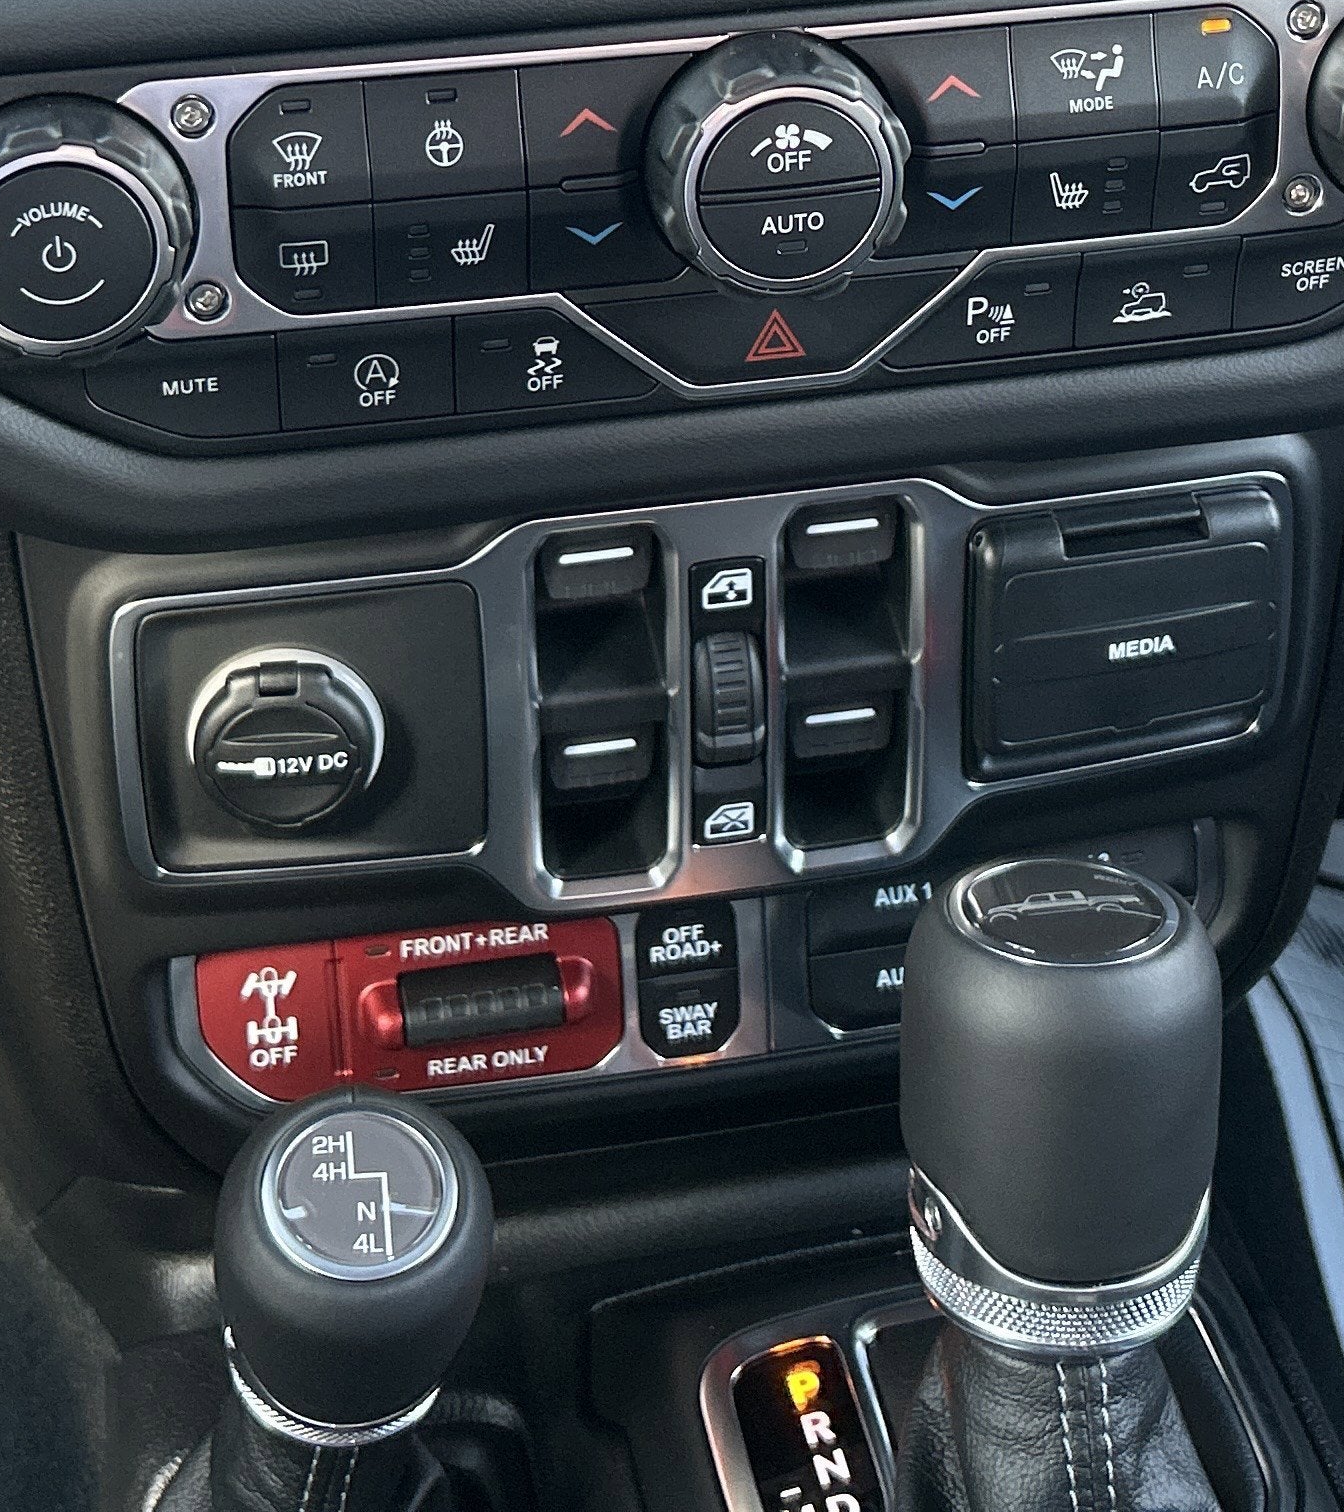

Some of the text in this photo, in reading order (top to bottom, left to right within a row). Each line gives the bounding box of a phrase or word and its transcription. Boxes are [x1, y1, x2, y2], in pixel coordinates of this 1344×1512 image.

[1197, 64, 1245, 90] A/C
[1069, 96, 1114, 113] MODE
[767, 150, 812, 174] OFF
[273, 171, 328, 189] FRONT
[17, 202, 90, 229] VOLUME
[761, 212, 824, 236] AUTO
[1296, 273, 1330, 292] OFF
[976, 328, 1012, 344] OFF
[162, 377, 219, 396] MUTE
[526, 373, 564, 392] OFF
[359, 388, 396, 406] OFF
[1108, 635, 1175, 661] MEDIA
[276, 751, 349, 775] 12V DC
[875, 882, 932, 907] AUX 1
[400, 923, 549, 958] FRONT+REAR
[662, 923, 705, 944] OFF
[649, 941, 723, 963] ROAD+
[876, 967, 904, 988] AU
[658, 1002, 718, 1025] SWAY
[666, 1019, 713, 1040] BAR
[250, 1045, 298, 1067] OFF
[428, 1046, 548, 1076] REAR ONLY
[312, 1135, 345, 1155] 2H
[312, 1162, 346, 1181] 4H
[357, 1201, 376, 1221] N
[353, 1233, 384, 1253] 4L
[786, 1360, 821, 1412] P
[800, 1411, 837, 1445] R
[813, 1448, 851, 1488] N
